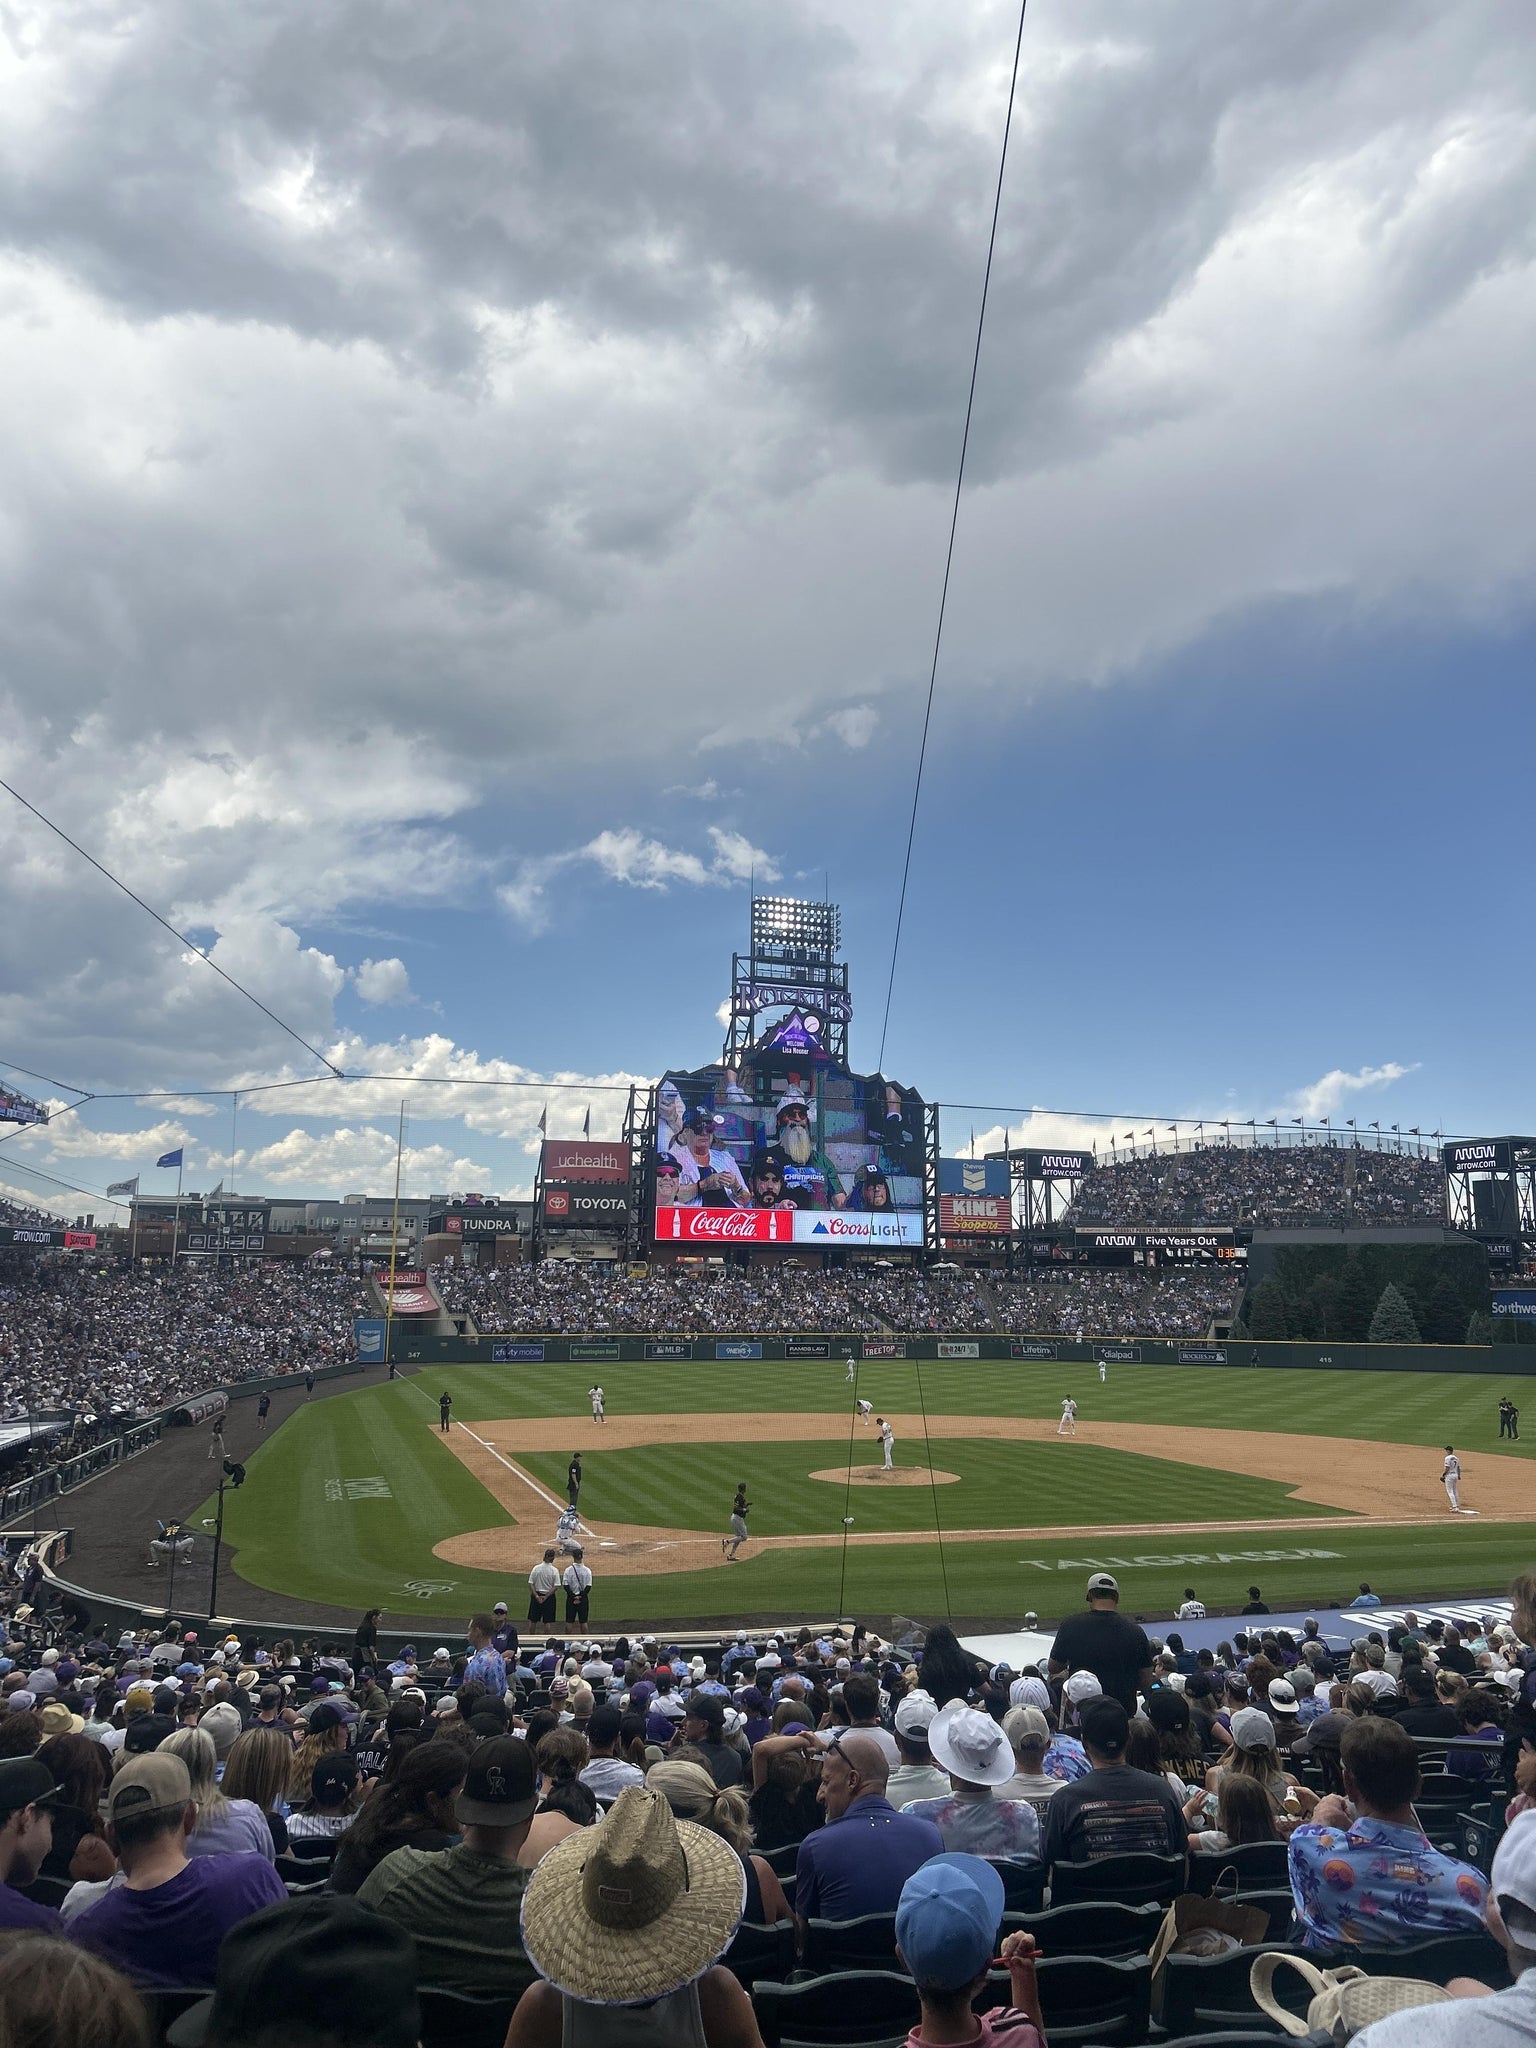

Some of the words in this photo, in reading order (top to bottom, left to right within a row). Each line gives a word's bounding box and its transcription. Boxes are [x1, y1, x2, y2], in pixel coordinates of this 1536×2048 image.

[738, 984, 853, 1020] ROCKIES
[1455, 1145, 1496, 1161] ARROW
[558, 1152, 618, 1169] uchealth
[1041, 1155, 1082, 1169] ARROW
[1455, 1160, 1496, 1171] arrow.com
[1042, 1168, 1082, 1177] arrow.com
[573, 1198, 627, 1210] TOYOTA
[952, 1200, 998, 1217] KING
[462, 1219, 512, 1230] TUNDRA
[690, 1211, 760, 1236] Coca-Cola
[829, 1218, 870, 1235] Coors
[872, 1225, 908, 1237] LIGHT
[951, 1216, 1000, 1231] Soopers
[13, 1230, 51, 1243] arrow.com
[1095, 1236, 1137, 1246] ARROW
[1145, 1236, 1167, 1246] Five
[1168, 1236, 1196, 1246] Years
[1197, 1236, 1218, 1246] Out
[519, 1348, 543, 1356] mobile
[1022, 1345, 1052, 1354] Lifetim
[1104, 1349, 1133, 1359] dialpad
[1017, 1549, 1296, 1571] TALLGRASS
